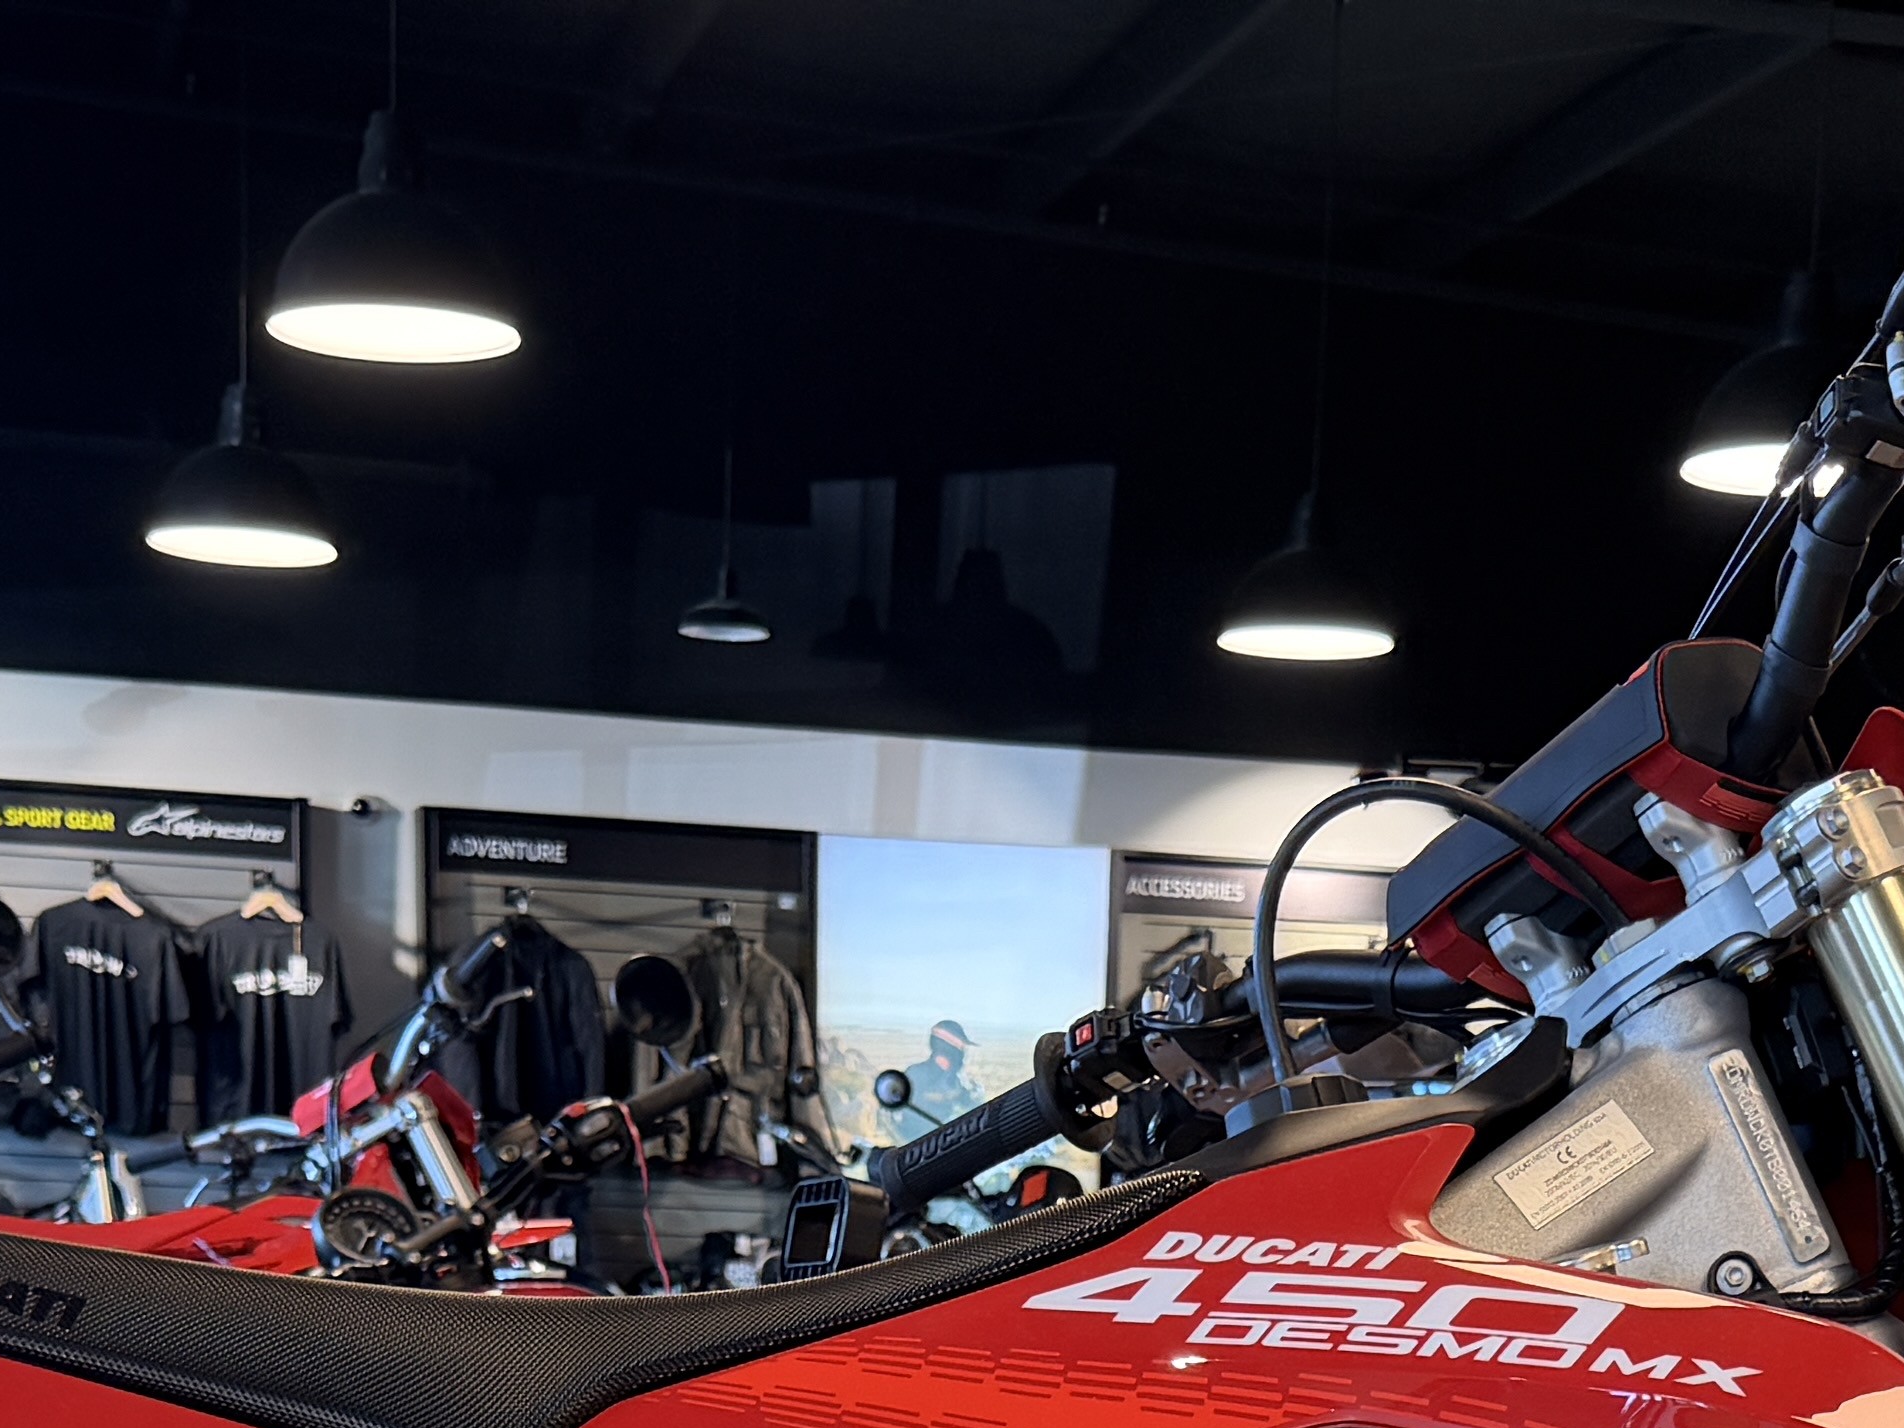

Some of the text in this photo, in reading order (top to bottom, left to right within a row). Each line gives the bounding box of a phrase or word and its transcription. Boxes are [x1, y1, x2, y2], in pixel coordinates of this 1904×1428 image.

[3, 807, 63, 829] SPORT
[64, 810, 116, 833] GEAR
[447, 833, 569, 864] ADVENTURE
[1125, 876, 1247, 903] ACCESSORIES
[902, 1103, 992, 1170] DUCATI
[1143, 1231, 1403, 1270] DUCATI
[1021, 1266, 1626, 1345] 450
[1186, 1317, 1764, 1398] DESMO MX
